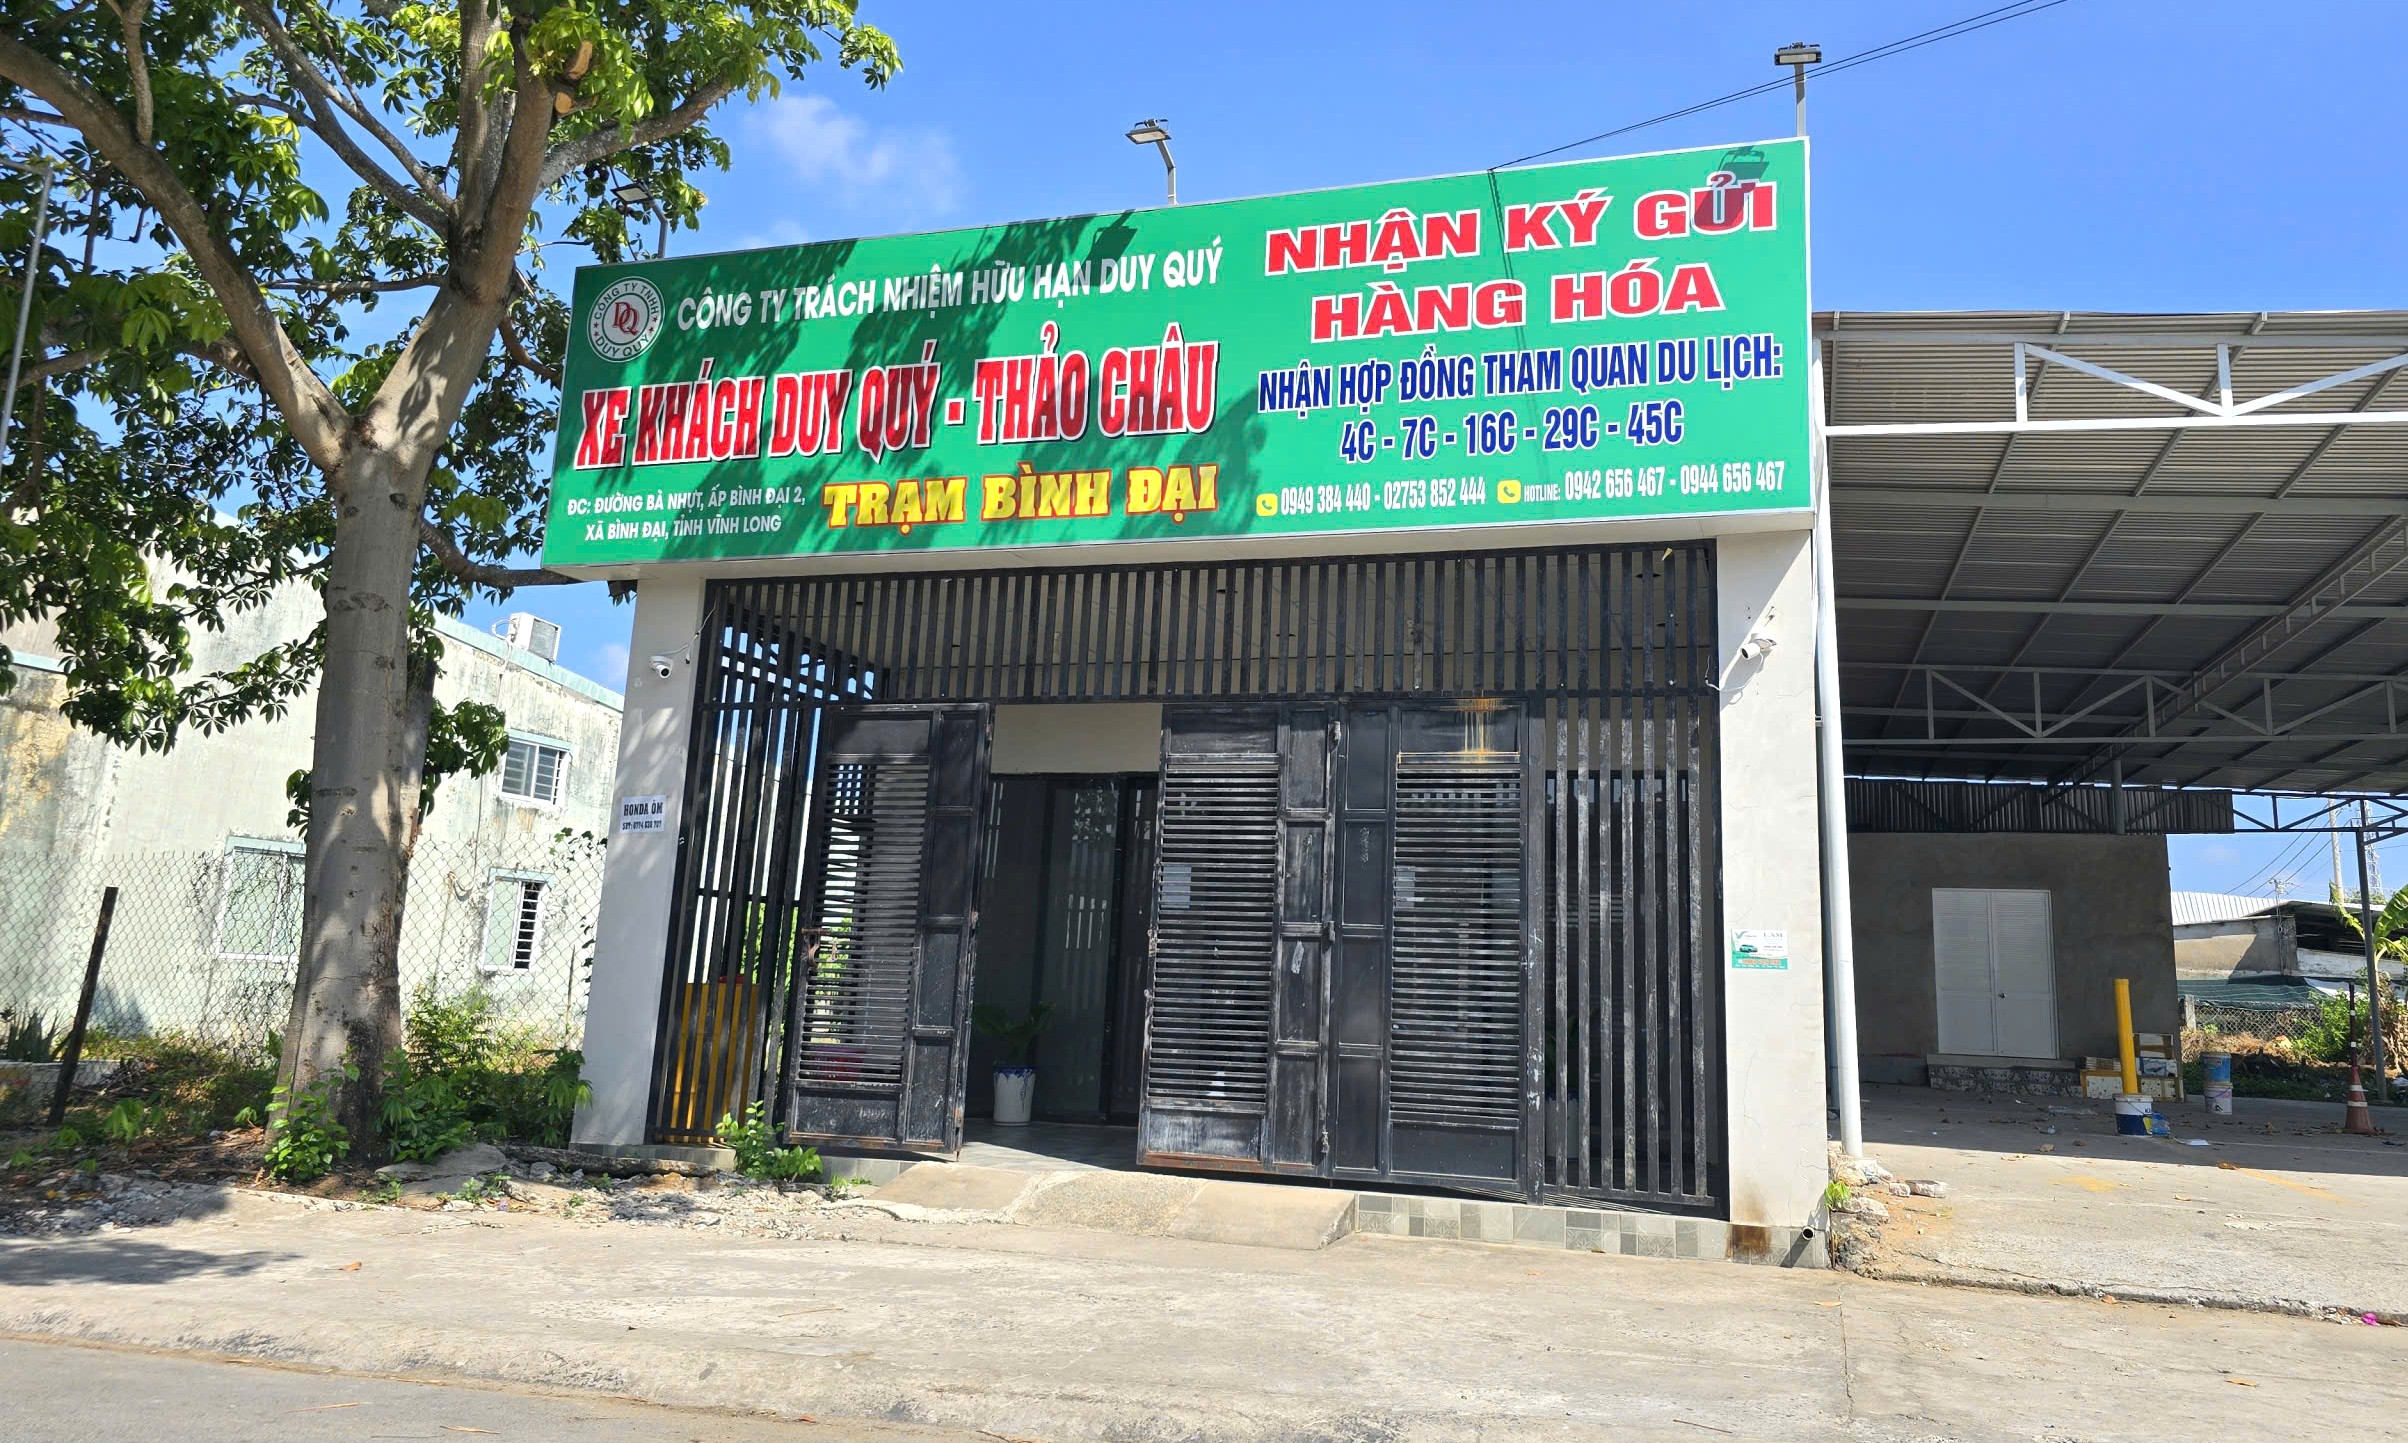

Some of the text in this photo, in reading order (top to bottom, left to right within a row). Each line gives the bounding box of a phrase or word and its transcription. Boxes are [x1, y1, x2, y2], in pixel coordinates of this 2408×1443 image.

[1264, 170, 1778, 276] NHẬN KÝ GỬI
[624, 282, 638, 291] TY
[640, 285, 659, 315] TNHH
[677, 235, 1224, 331] CÔNG TY TRÁCH NHIỆM HỮU HẠN DUY QUÝ
[1310, 256, 1727, 344] HÀNG HÓA
[595, 336, 620, 357] DUY
[573, 386, 631, 470] XE
[632, 357, 766, 467] KHÁCH
[768, 369, 853, 458] DUY
[856, 339, 942, 464] QUÝ
[973, 320, 1091, 445] THẢO
[1098, 322, 1222, 437] CHÂU
[1257, 332, 1784, 420] NHẬN HỢP ĐỒNG THAM QUAN DU LỊCH:
[1339, 419, 1377, 464] 4C
[1401, 414, 1438, 461] 7C
[1463, 409, 1518, 457] 16C
[1542, 404, 1600, 452] 29C
[1626, 398, 1685, 447] 45C
[567, 498, 591, 515] ĐC:
[594, 491, 644, 514] ĐƯỜNG
[646, 489, 664, 511] BÀ
[707, 483, 727, 508] ẤP
[729, 484, 762, 507] BÌNH
[765, 486, 790, 509] ĐẠI
[793, 485, 806, 506] 2,
[822, 461, 1221, 537] TRẠM BÌNH ĐẠI
[1281, 486, 1314, 516] 0949
[1317, 484, 1342, 513] 384
[1345, 482, 1371, 512] 440
[1384, 479, 1427, 510] 02753
[1430, 477, 1457, 508] 852
[1459, 476, 1486, 505] 444
[1523, 483, 1561, 503] HOTLINE:
[1565, 469, 1601, 501] 0942
[1605, 468, 1633, 499] 656
[1637, 466, 1665, 497] 467
[1680, 463, 1718, 495] 0944
[1722, 462, 1751, 493] 656
[1755, 460, 1785, 492] 467
[585, 513, 782, 543] XÃ BÌNH ĐẠI, TỈNH VĨNH LONG
[623, 799, 663, 816] HONDA ÔM
